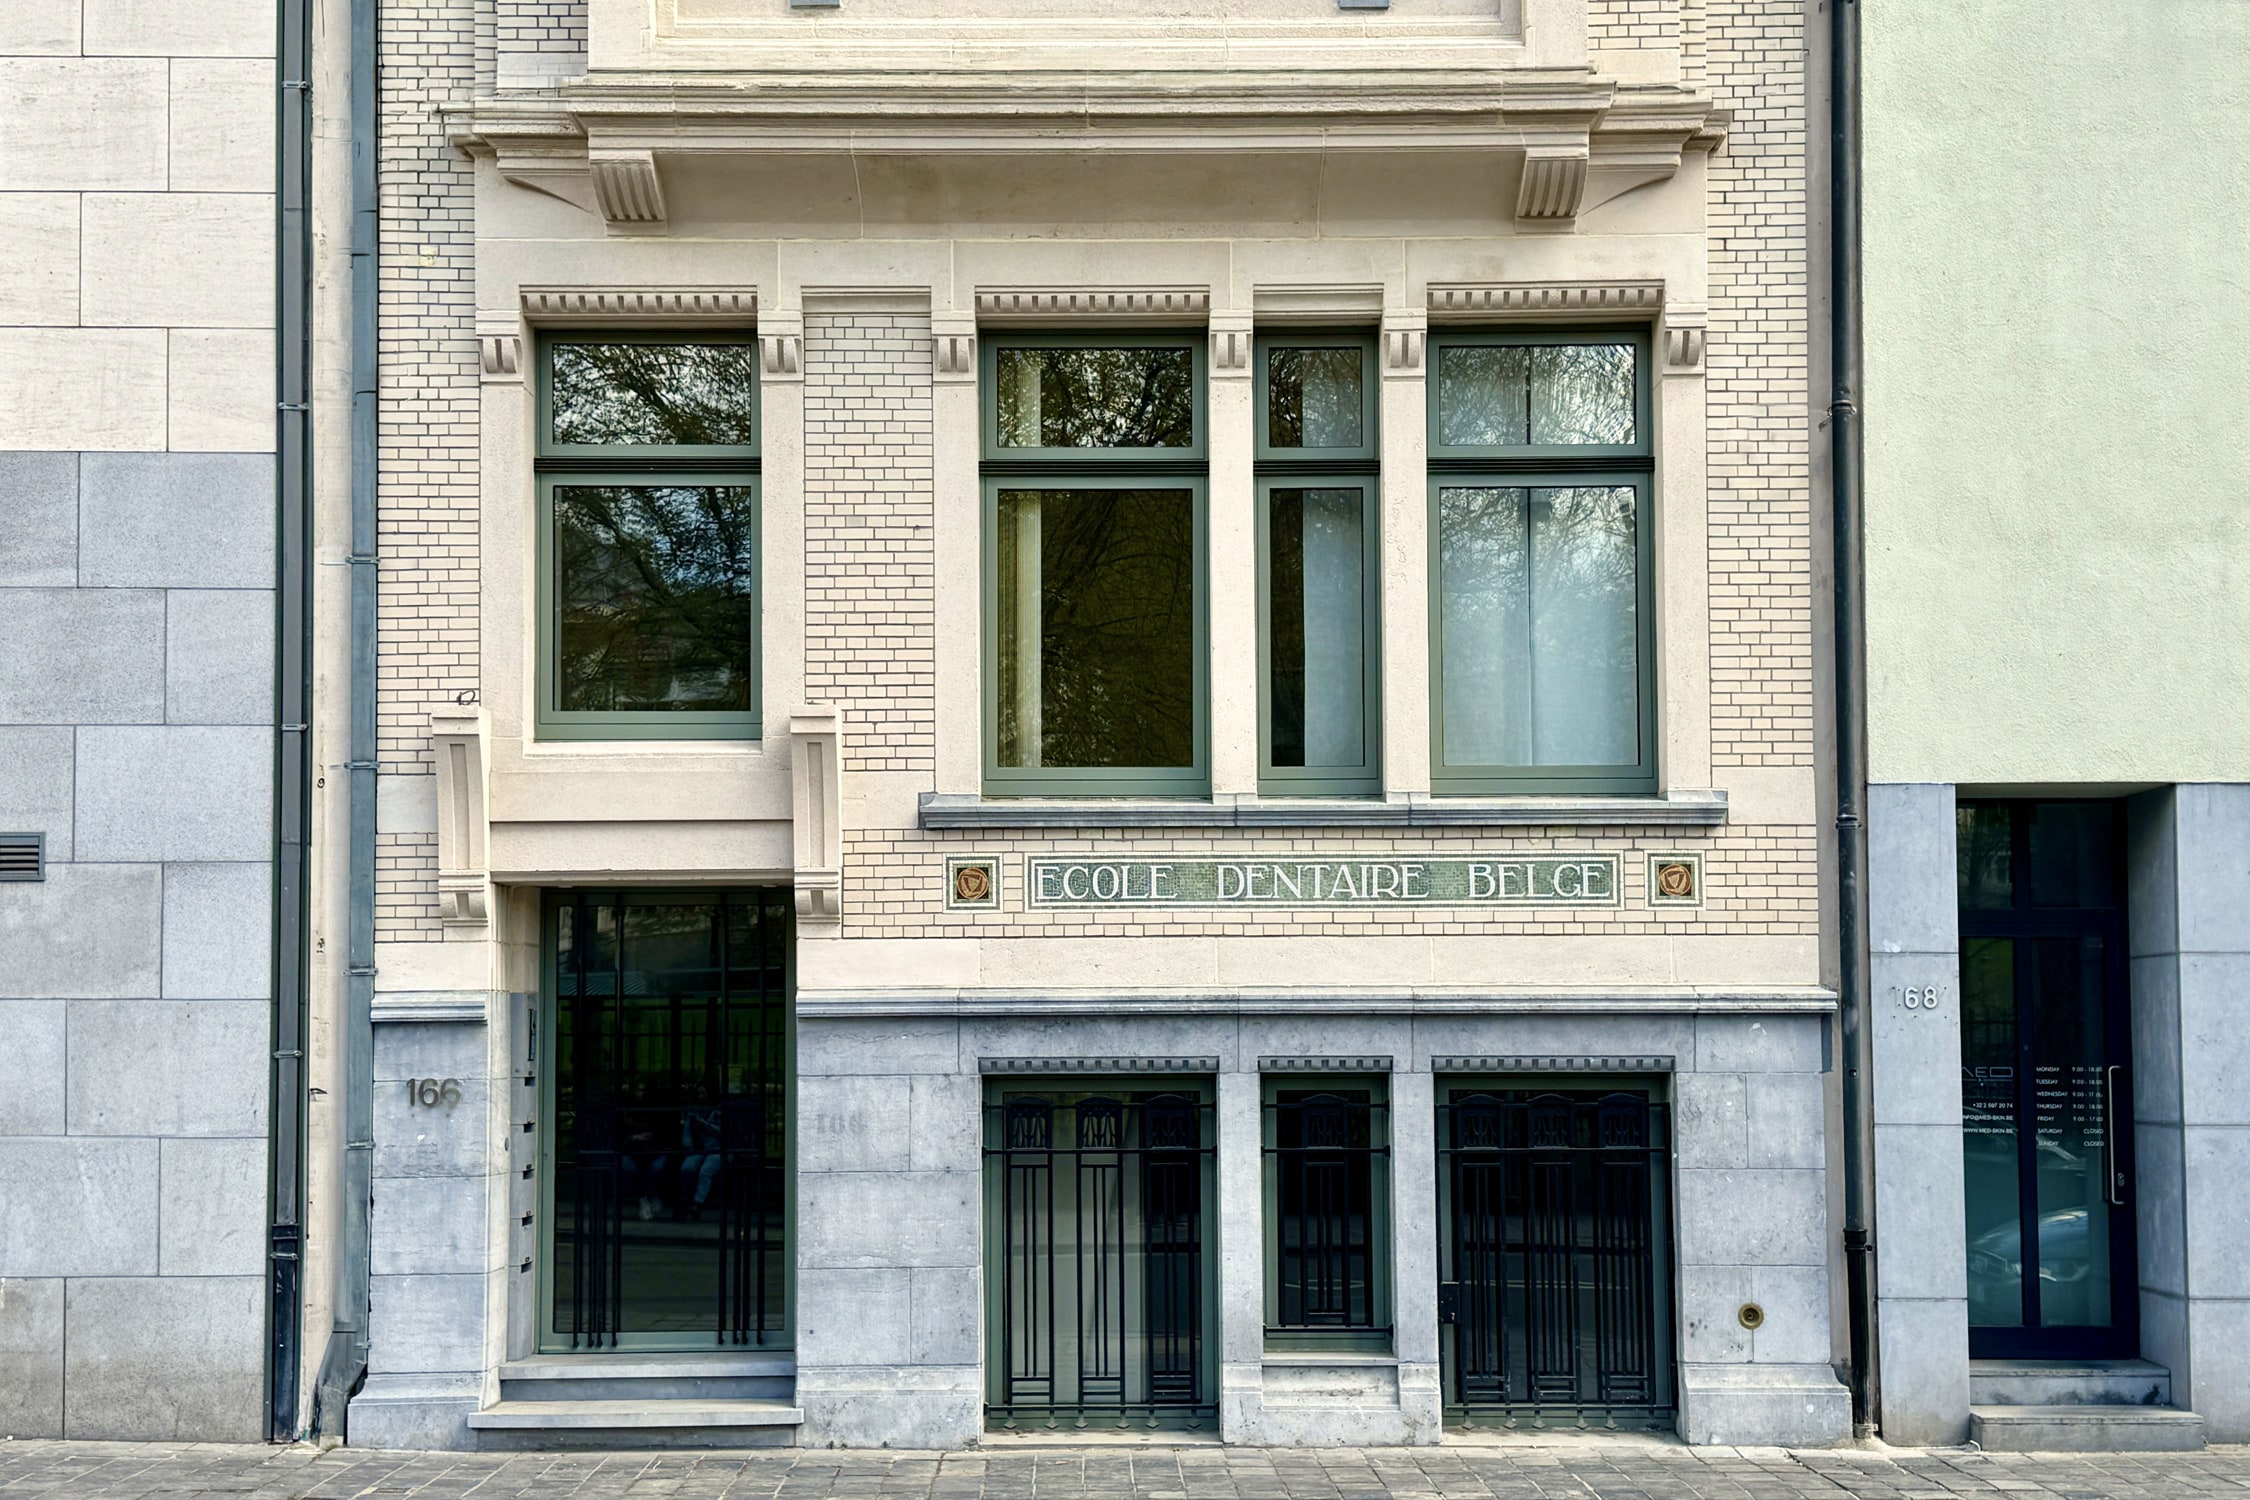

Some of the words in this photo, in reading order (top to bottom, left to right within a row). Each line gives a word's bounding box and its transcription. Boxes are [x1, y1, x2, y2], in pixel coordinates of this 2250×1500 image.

[1036, 864, 1177, 900] ECOLE
[1216, 864, 1430, 899] DENTAIRE
[1467, 863, 1611, 898] BELGE
[1904, 986, 1938, 1010] 68
[406, 1078, 461, 1109] 166
